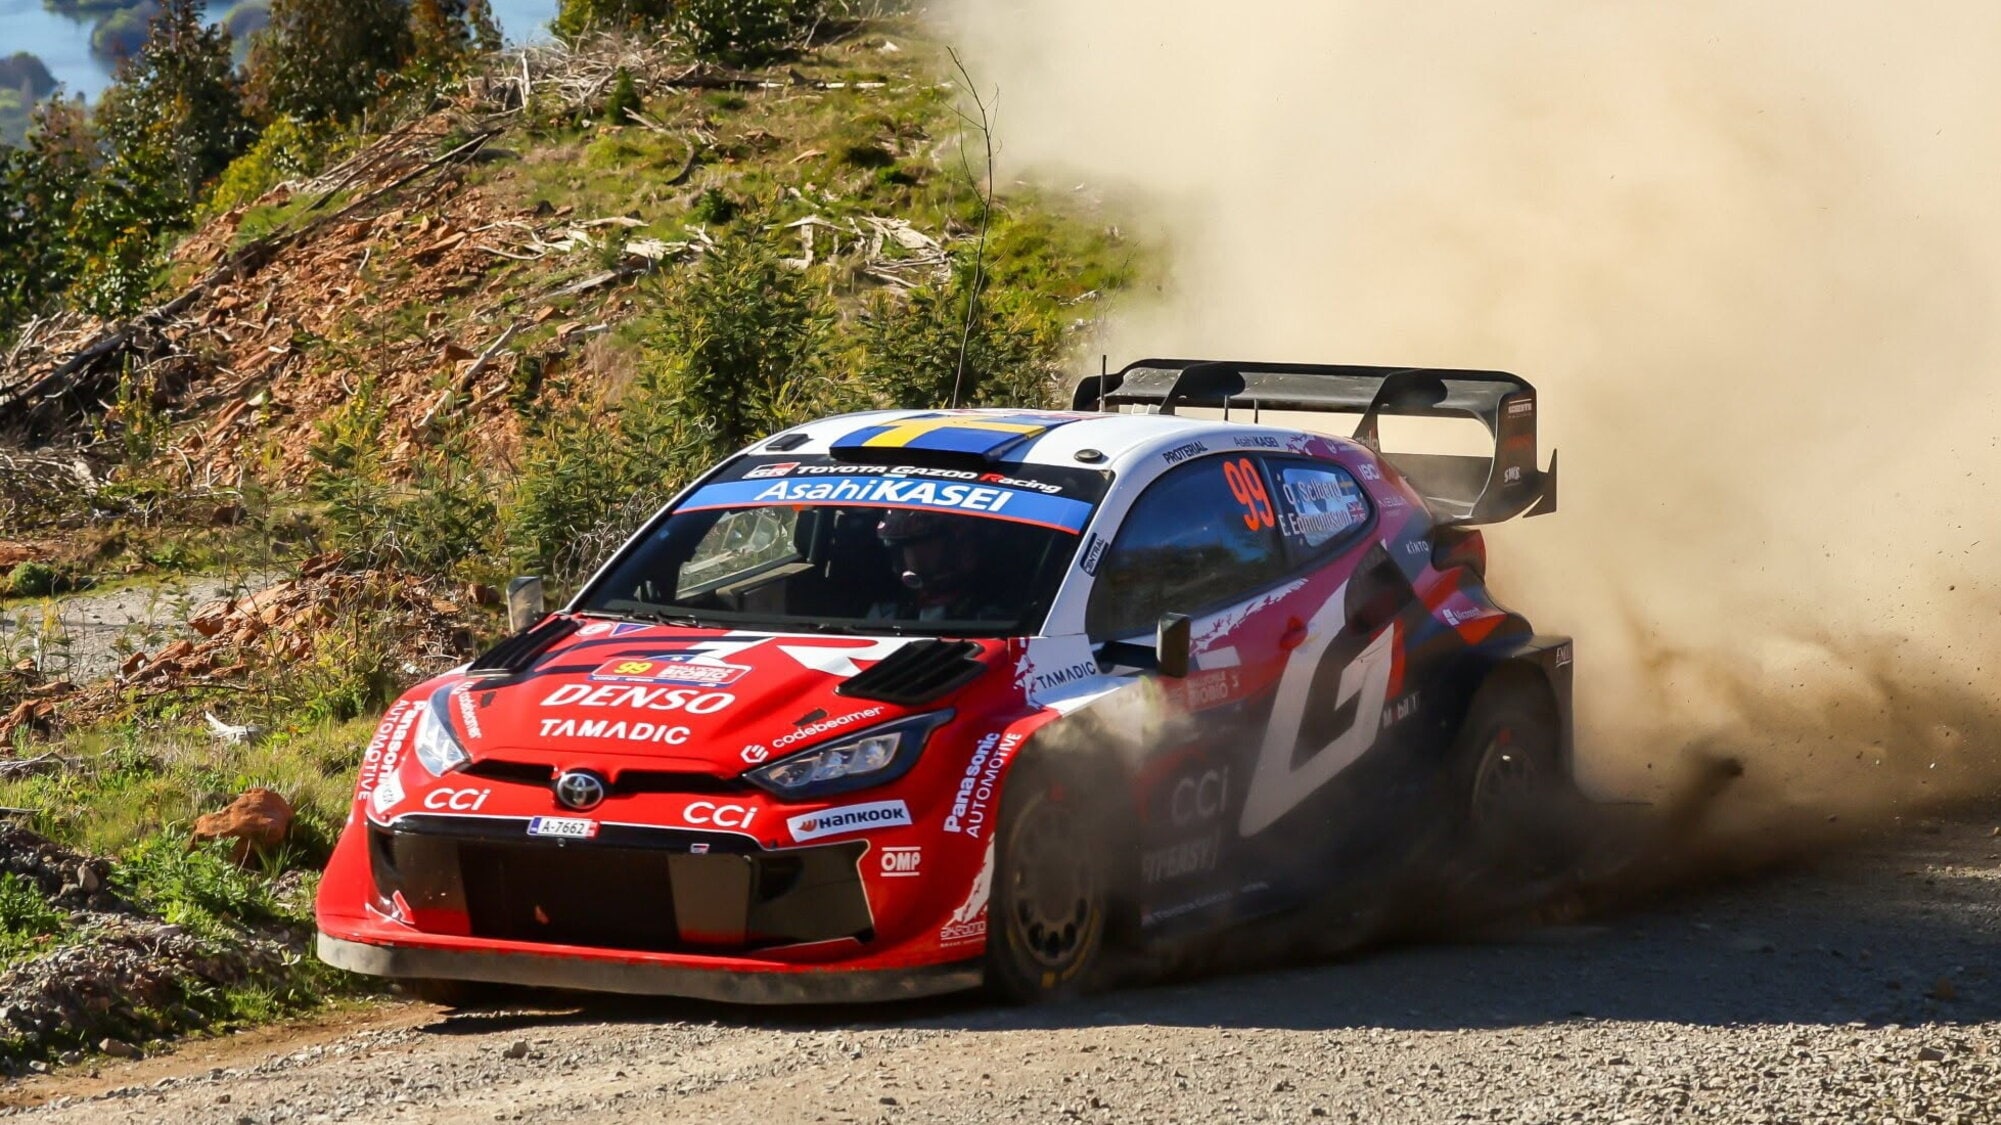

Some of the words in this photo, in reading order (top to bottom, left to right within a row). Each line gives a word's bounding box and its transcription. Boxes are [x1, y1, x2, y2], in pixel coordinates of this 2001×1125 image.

[1162, 440, 1208, 464] PROTERIAL
[797, 464, 887, 476] TOYOTA
[980, 472, 1063, 494] Racing
[1224, 457, 1275, 531] 99
[613, 661, 653, 675] 99
[1036, 661, 1096, 690] TAMADIC
[539, 684, 736, 715] DENSO
[539, 718, 692, 745] TAMADIC
[772, 706, 881, 749] codebeamer
[358, 700, 409, 801] AUTOMOTIVE
[943, 732, 1000, 833] Panasonic
[966, 732, 1022, 838] AUTOMOTIVE
[541, 820, 586, 834] A-7662
[880, 852, 921, 872] OMP
